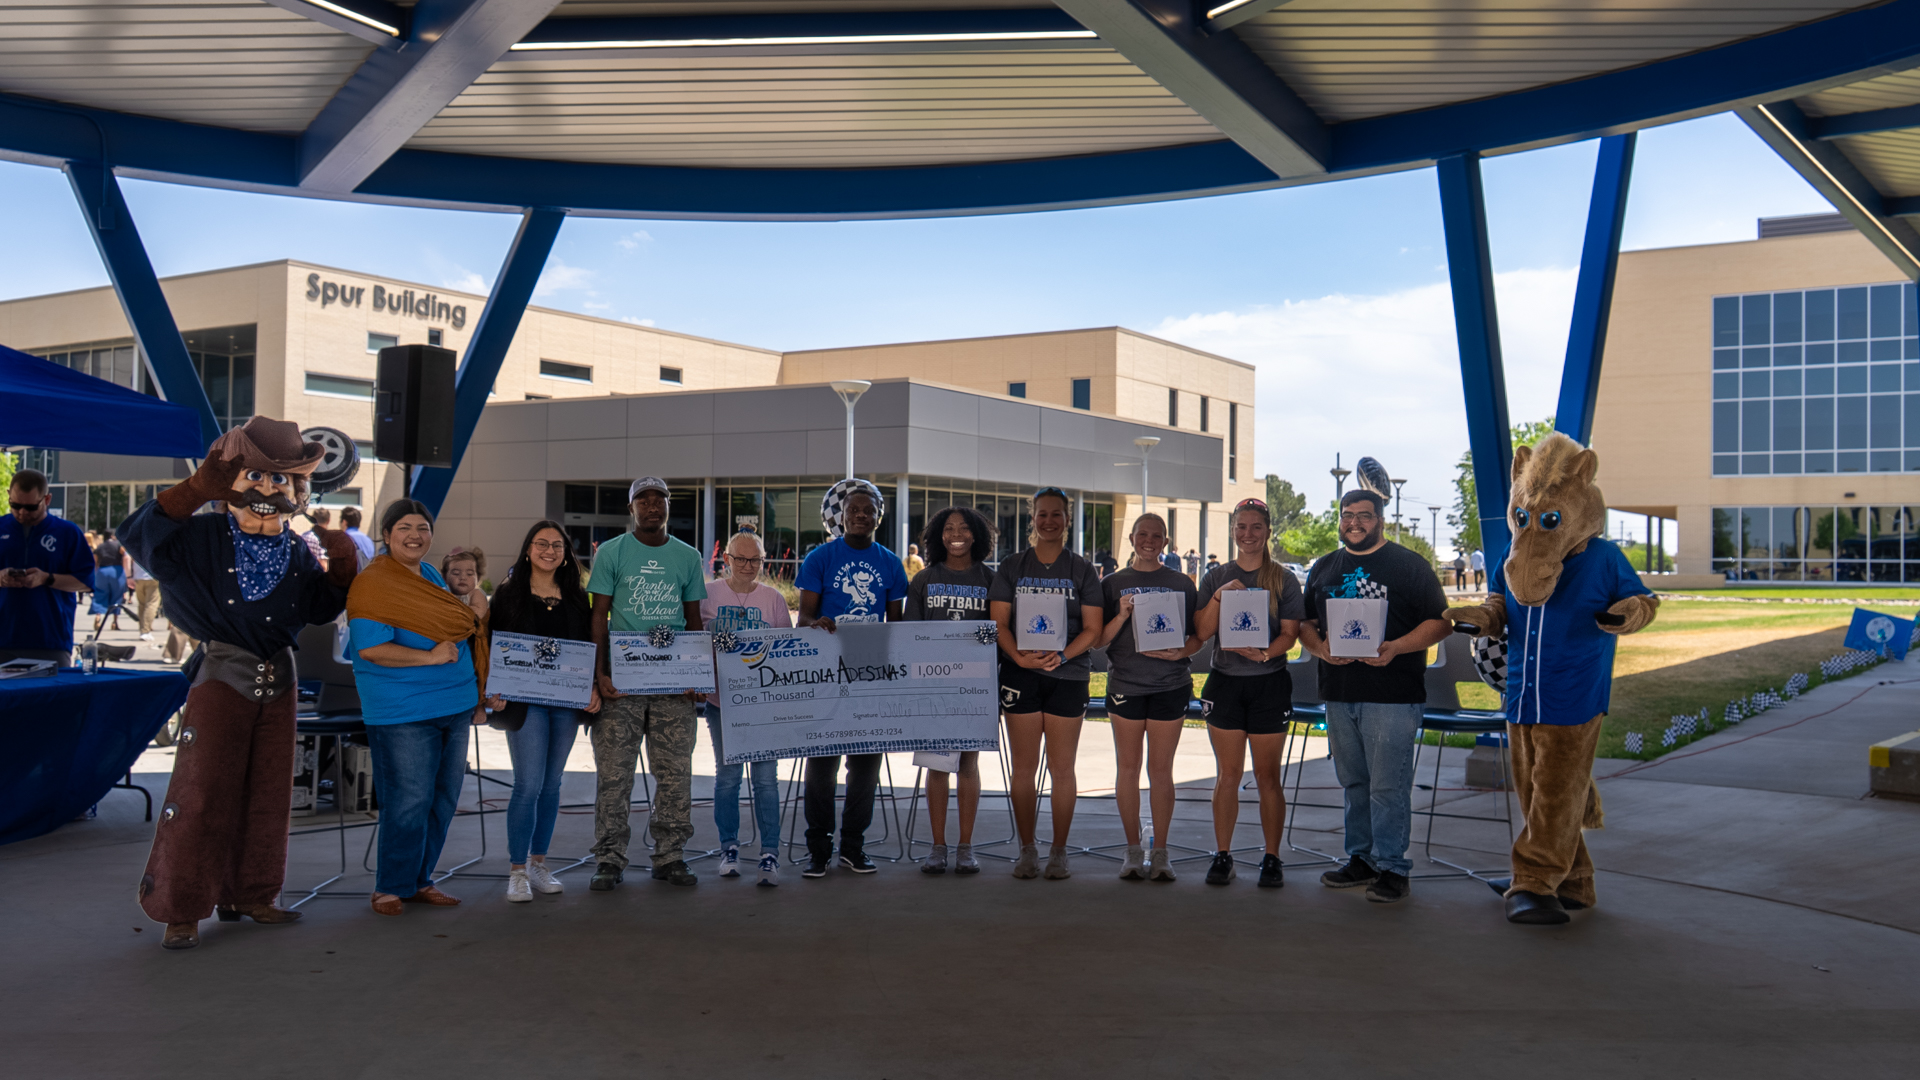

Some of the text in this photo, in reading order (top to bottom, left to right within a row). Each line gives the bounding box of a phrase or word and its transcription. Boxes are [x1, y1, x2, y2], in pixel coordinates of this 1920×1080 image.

[306, 273, 467, 328] Spur Building
[735, 515, 759, 524] CAMPUS
[833, 560, 884, 589] ODESSA COLLEGE
[628, 575, 676, 593] Pantry
[628, 587, 679, 605] Gardens
[927, 583, 988, 600] WRANGLER
[634, 601, 680, 616] Orchard
[927, 595, 987, 611] SOFTBALL
[747, 607, 761, 621] GO
[764, 633, 793, 641] COLLEGE
[768, 648, 819, 659] SUCCESS
[758, 655, 899, 688] DAMILOLA ADESINA
[899, 663, 908, 677] $
[728, 677, 740, 685] Pay
[731, 688, 815, 705] One Thousand
[959, 687, 989, 695] Dollars
[852, 712, 879, 721] Signature
[805, 727, 904, 741] 1234-567898765-432-1234
